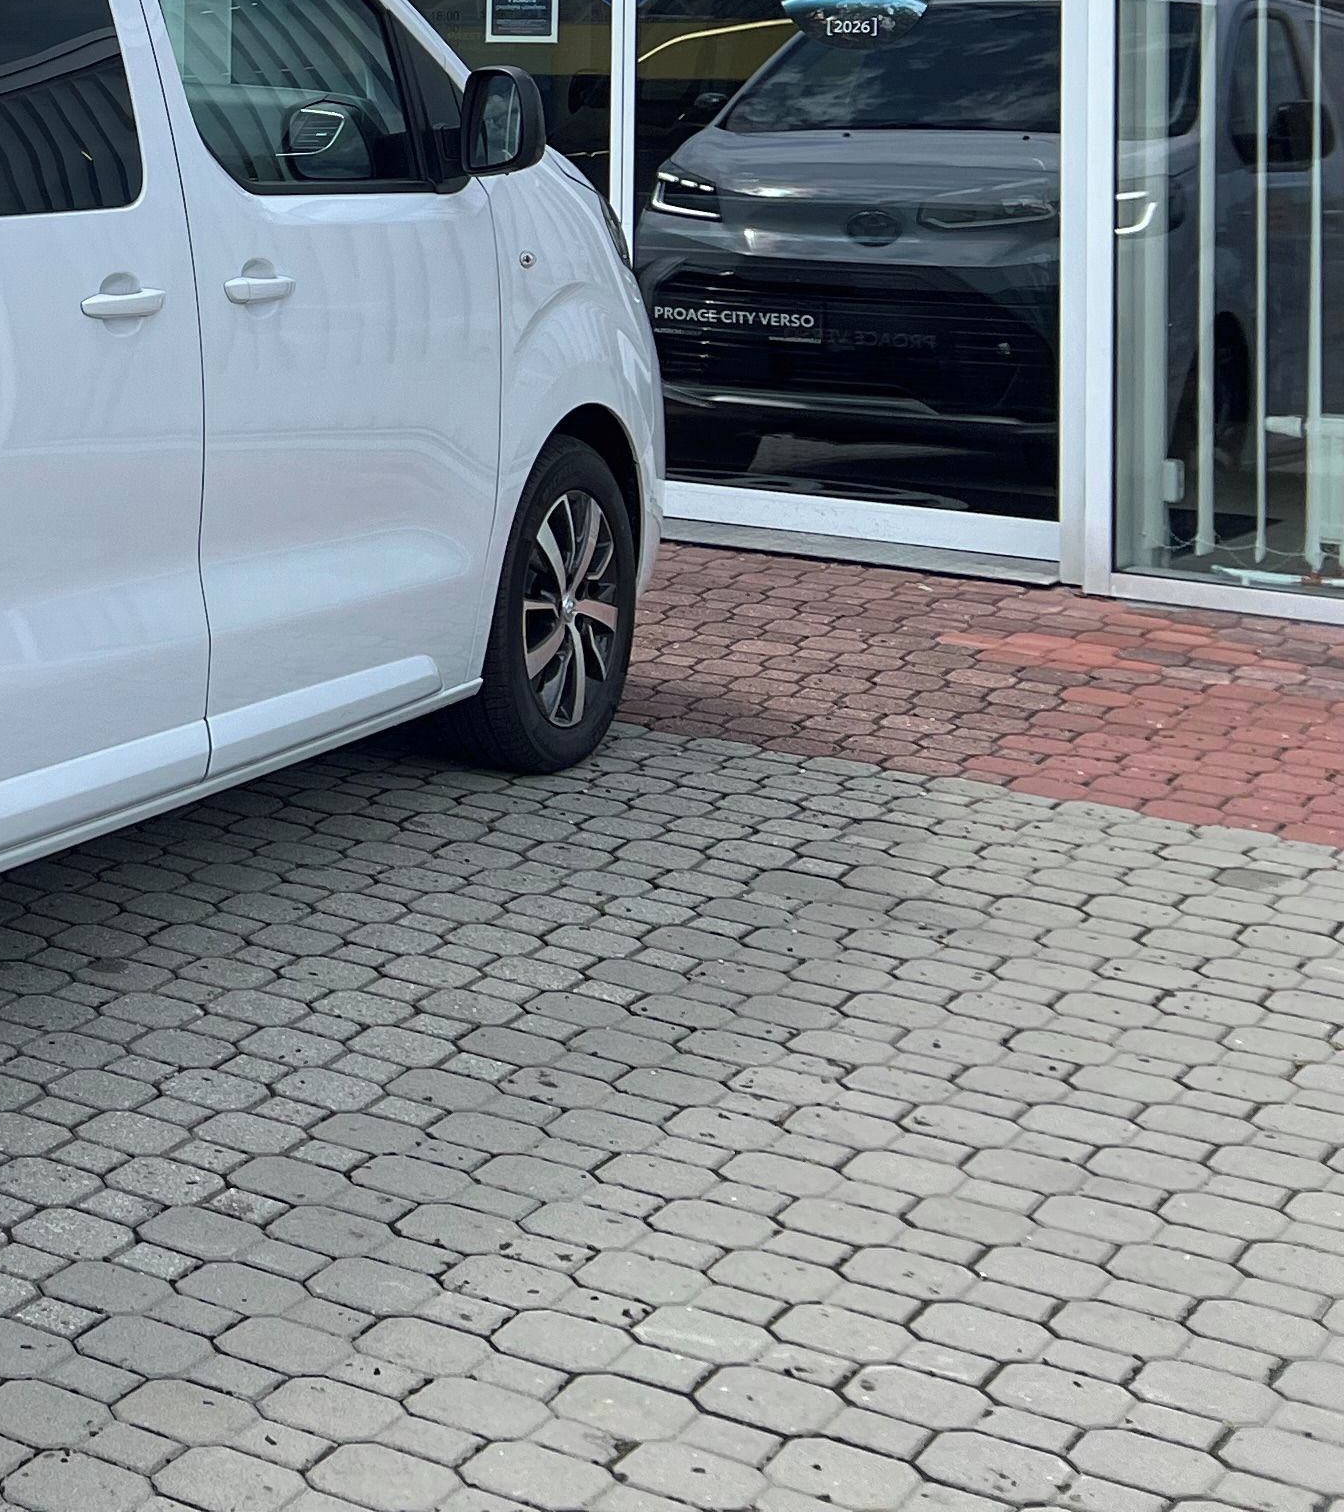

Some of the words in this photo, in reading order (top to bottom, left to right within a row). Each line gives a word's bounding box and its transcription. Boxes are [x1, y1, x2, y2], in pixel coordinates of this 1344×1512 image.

[826, 17, 878, 36] [2026]
[654, 306, 718, 323] PROACE
[720, 310, 756, 325] CITY
[759, 312, 815, 328] VERSO
